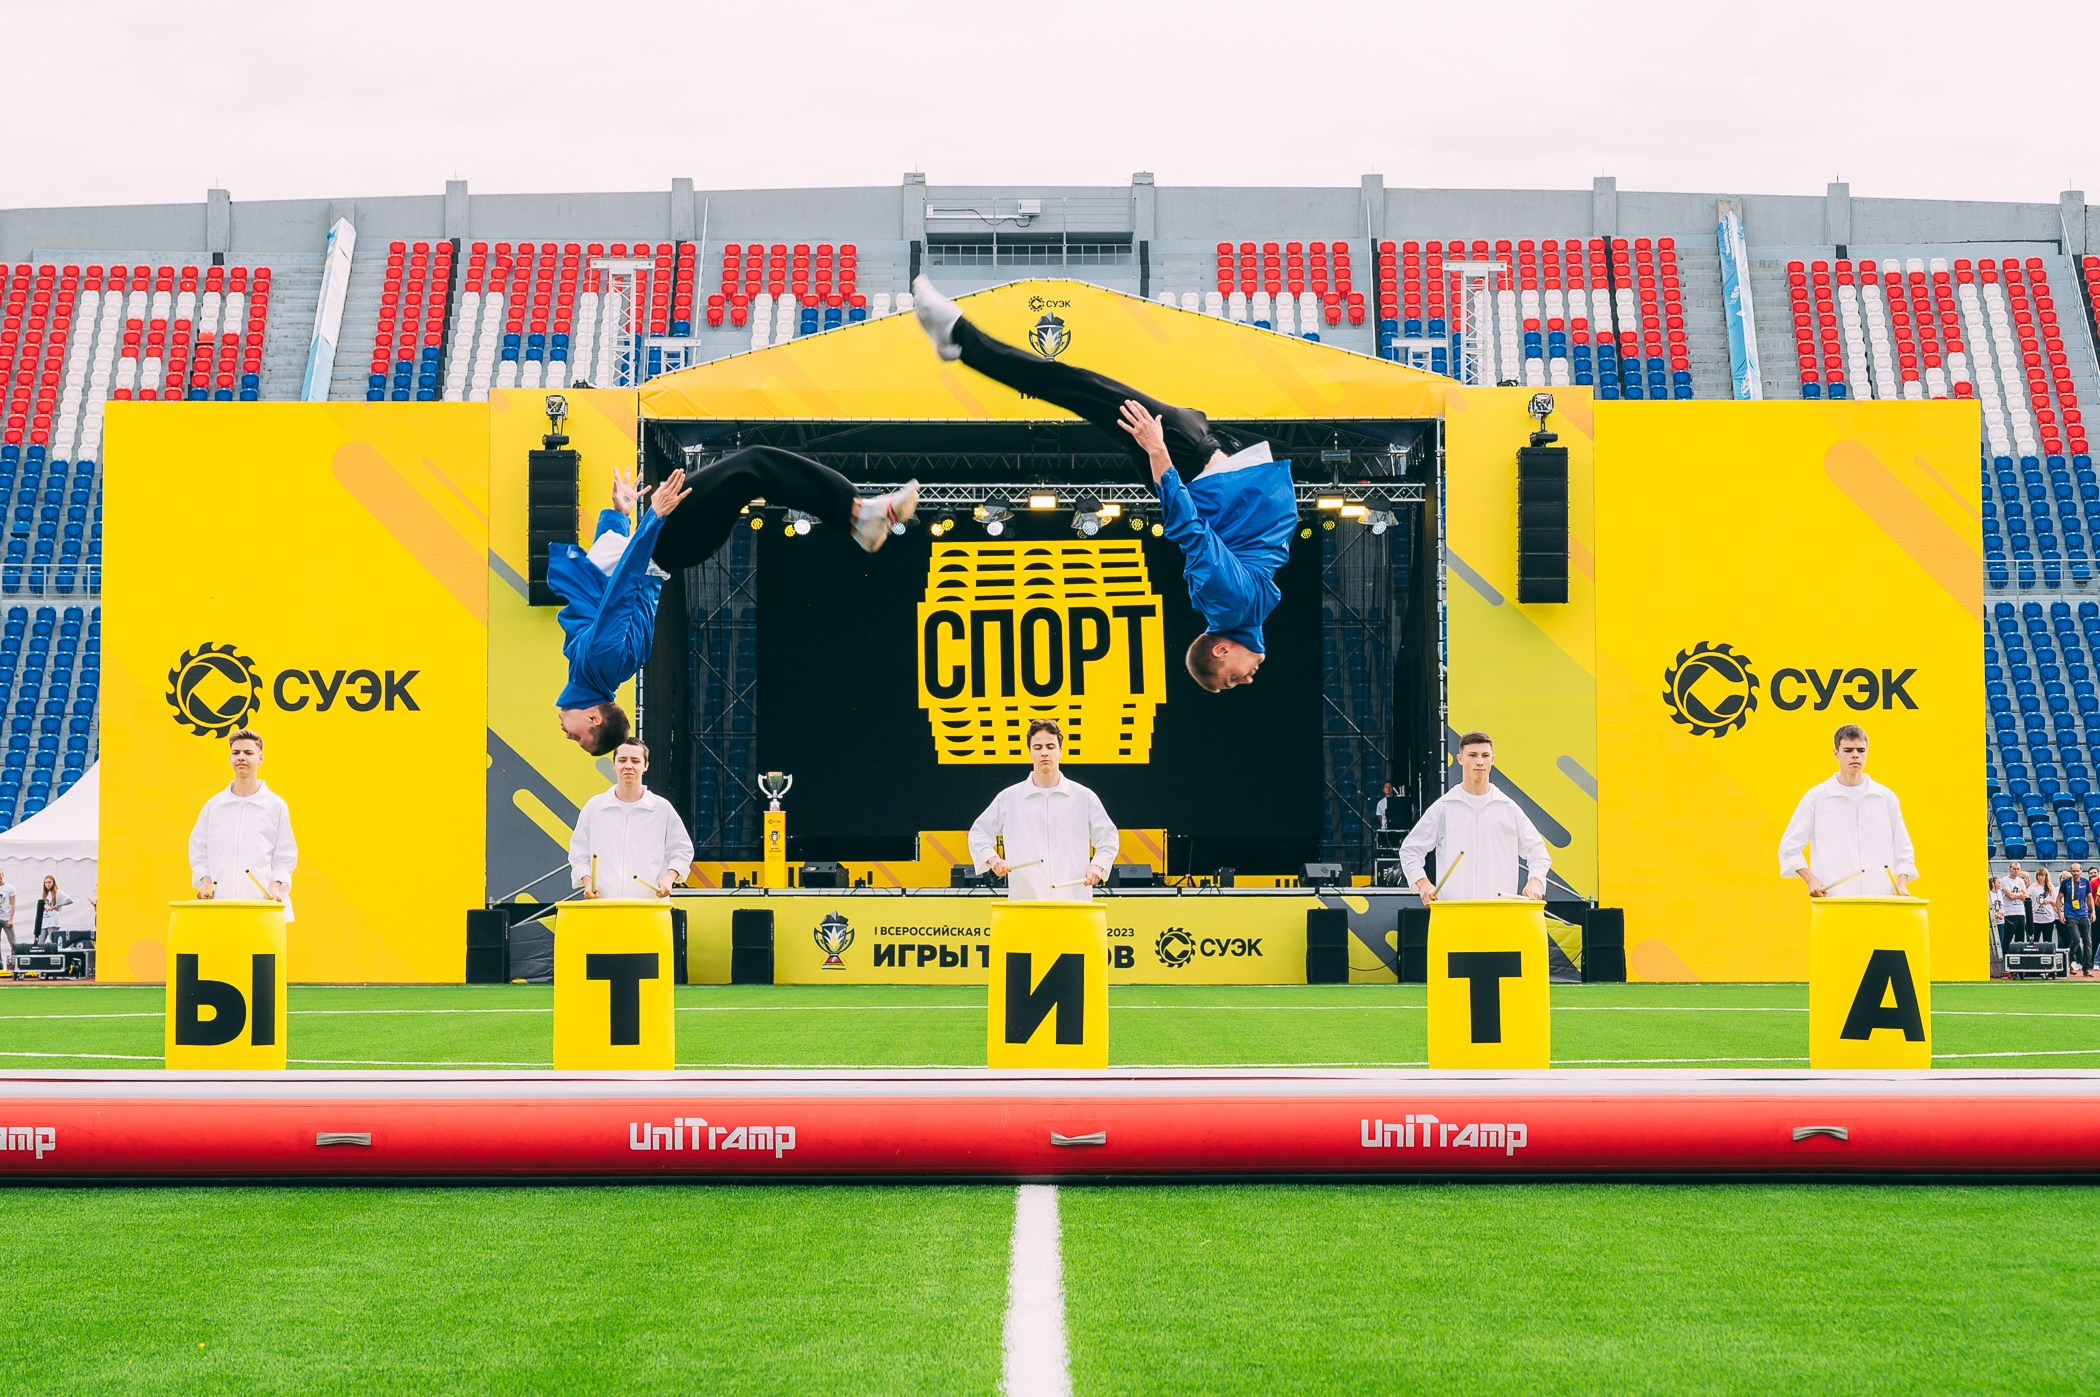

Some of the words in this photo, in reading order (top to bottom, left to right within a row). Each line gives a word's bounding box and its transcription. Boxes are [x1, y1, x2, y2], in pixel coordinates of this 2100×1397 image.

[1046, 300, 1071, 308] СУЭК
[924, 604, 1156, 700] СПОРТ
[273, 668, 421, 712] СУЭК
[1770, 667, 1919, 711] СУЭК
[873, 944, 969, 968] ИГРЫ
[880, 925, 981, 937] ВСЕРОССИЙСКАЯ
[1106, 928, 1135, 937] 2023
[1200, 938, 1264, 957] СУЭК
[175, 953, 276, 1047] Ы
[585, 952, 660, 1046] Т
[1004, 952, 1085, 1045] И
[1447, 951, 1522, 1044] Т
[1839, 949, 1926, 1042] А
